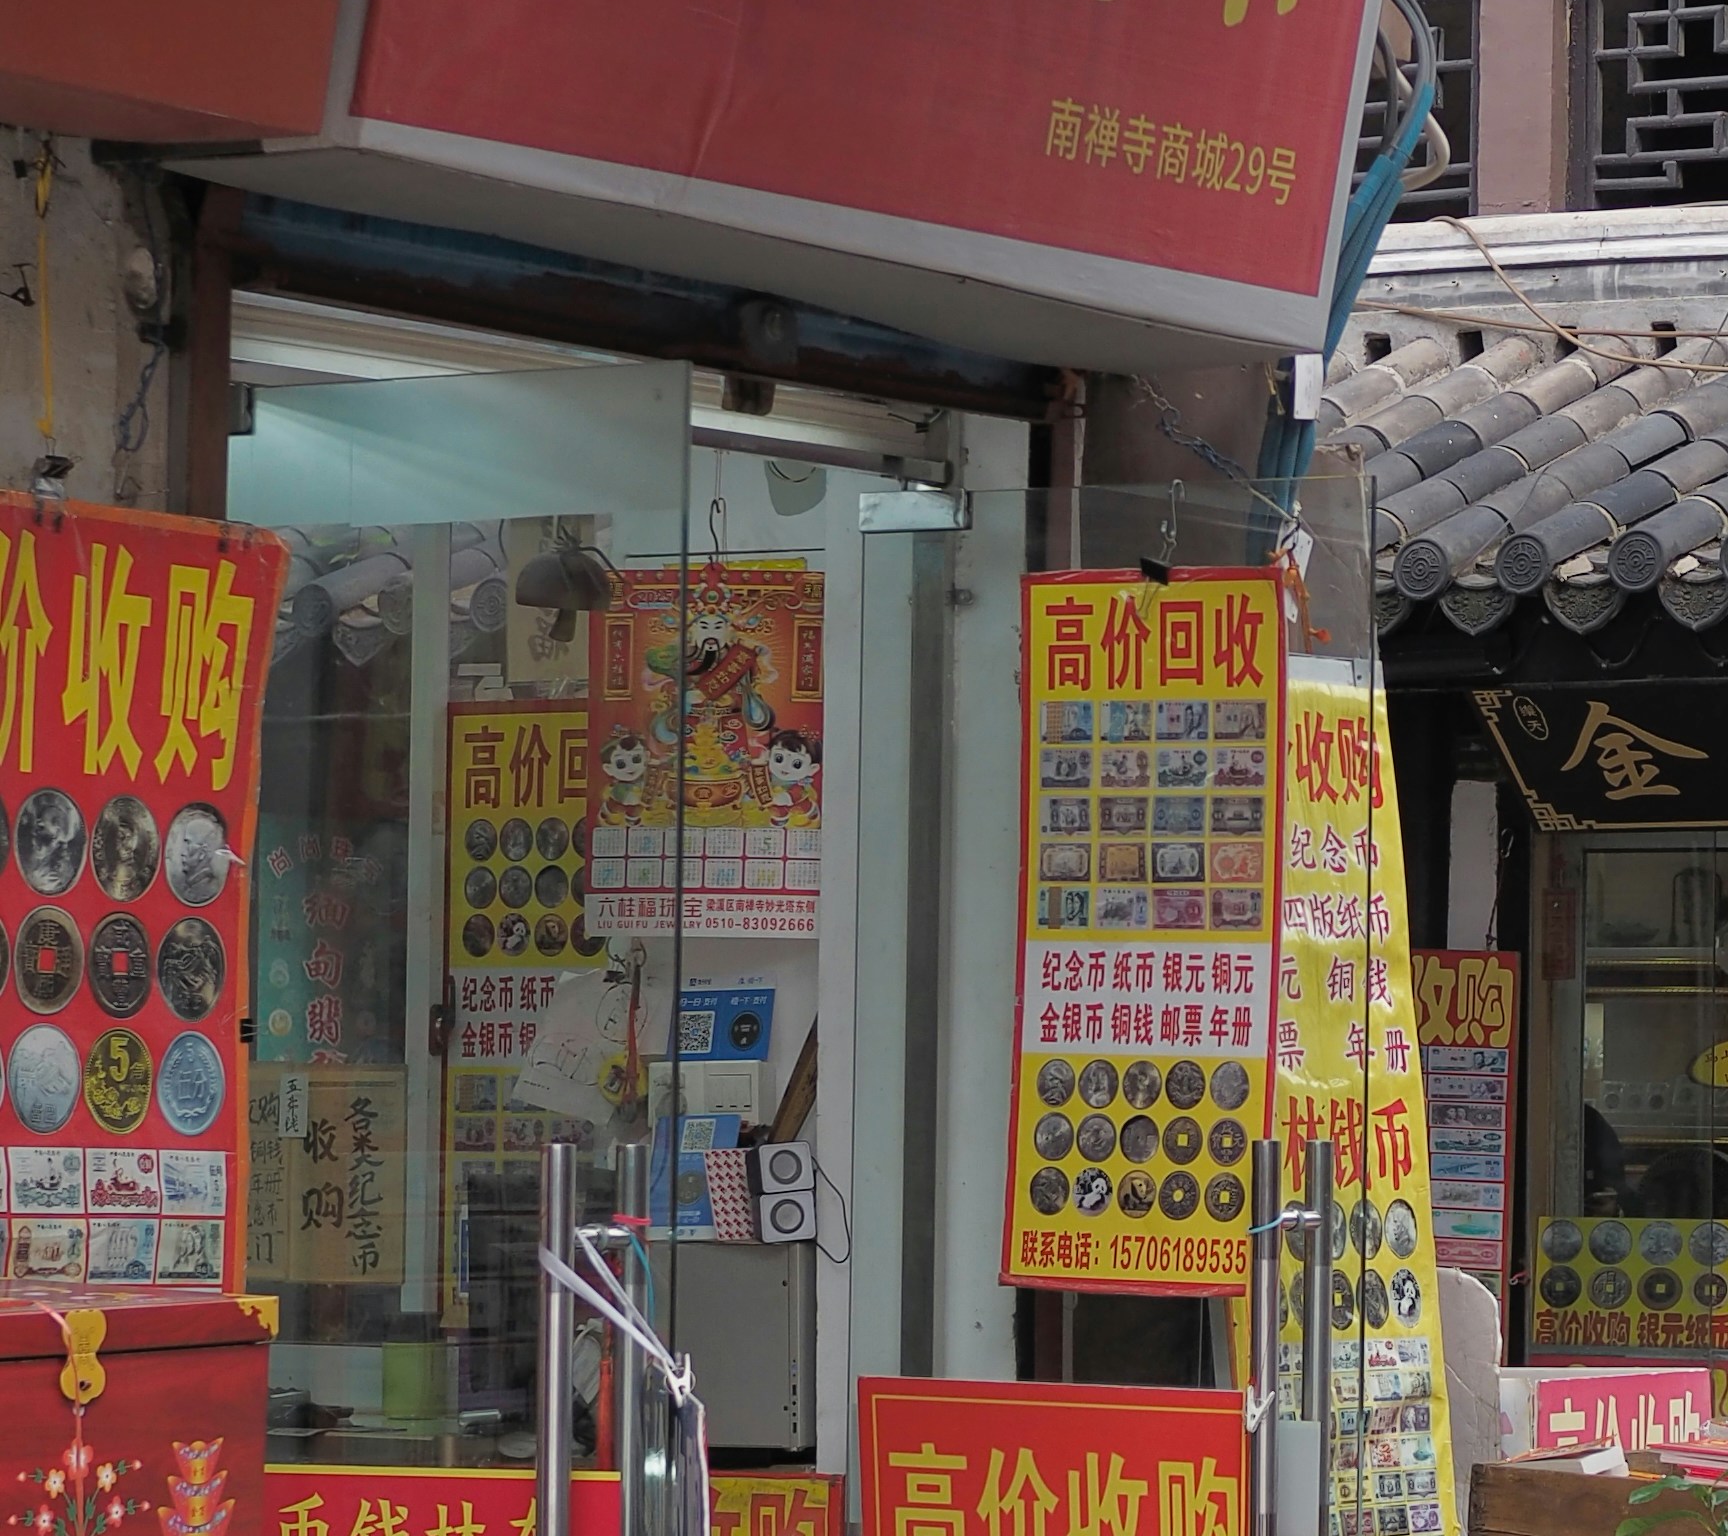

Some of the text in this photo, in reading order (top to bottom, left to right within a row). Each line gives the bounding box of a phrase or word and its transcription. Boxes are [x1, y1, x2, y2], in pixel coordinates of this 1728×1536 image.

[1045, 97, 1297, 206] 南禅寺商城29号
[0, 529, 255, 791] 价收购
[1045, 593, 1264, 691] 高价回收
[1287, 711, 1384, 808] 收购
[1290, 823, 1379, 874] 纪念币
[653, 921, 702, 929] JEWLRY
[706, 917, 815, 931] 0510-83092666
[1283, 893, 1391, 944] 四版纸币
[462, 976, 514, 1012] 纪念币
[1041, 950, 1255, 994] 纪念币 纸币 银元 铜元
[461, 1022, 513, 1059] 金银币
[1039, 1001, 1253, 1047] 金银币 铜钱 邮票 年册
[1345, 1023, 1411, 1073] 年册
[302, 1119, 344, 1231] 收购
[1536, 1310, 1630, 1346] 高价收购
